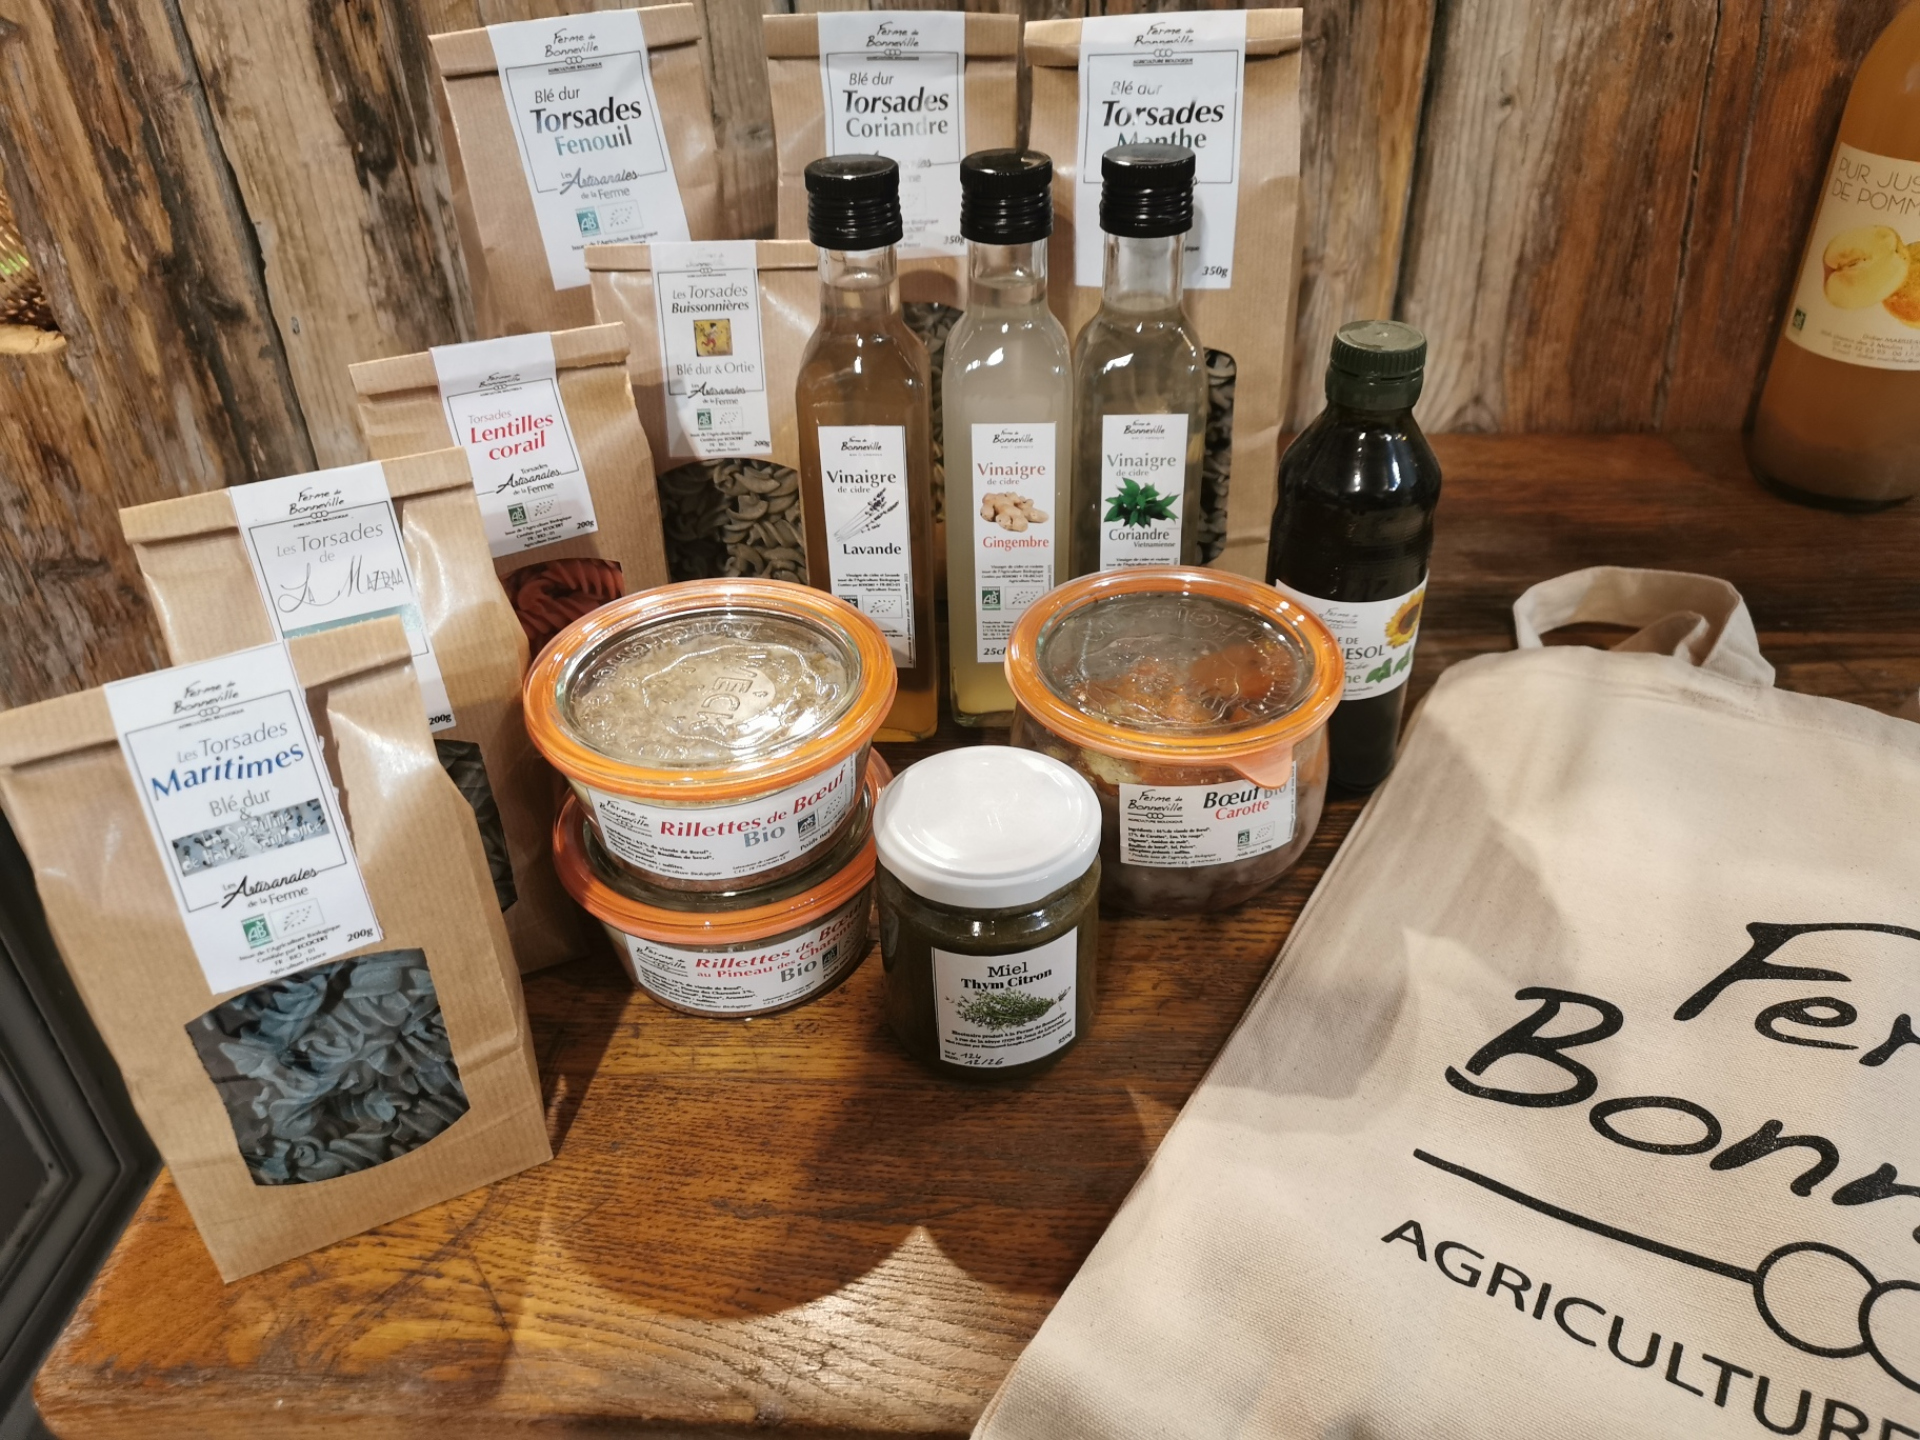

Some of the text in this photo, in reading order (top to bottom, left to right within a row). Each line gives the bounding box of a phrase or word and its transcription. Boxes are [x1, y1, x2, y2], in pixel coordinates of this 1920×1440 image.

[553, 28, 584, 44] Ferme
[876, 21, 907, 36] Ferme
[1146, 22, 1181, 36] Ferme
[866, 35, 919, 47] Bonneville
[545, 43, 598, 57] Bonneville
[849, 72, 894, 86] Blé dur
[535, 86, 580, 104] Blé dur
[1111, 80, 1133, 96] Blé
[842, 86, 949, 114] Torsades
[530, 96, 642, 134] Torsades
[1102, 98, 1225, 127] Torsades
[846, 115, 948, 138] Coriandre
[555, 124, 632, 156] Fenouil
[1838, 157, 1871, 184] PUR
[560, 167, 638, 195] Artisanales
[581, 192, 589, 200] de
[598, 187, 630, 200] Ferme
[1832, 177, 1853, 203] DE
[1202, 266, 1228, 278] 350g
[673, 283, 748, 300] Les Torsades
[671, 300, 750, 314] Buissonnières
[676, 361, 755, 376] Blé dur & Ortie
[688, 381, 746, 399] Artisanales
[715, 398, 739, 406] Ferme
[468, 409, 512, 425] Torsades
[470, 414, 554, 444] Lentilles
[1123, 425, 1165, 435] Bonneville
[489, 430, 546, 460] corail
[841, 441, 882, 451] Bonneville
[992, 433, 1033, 443] Bonneville
[1107, 453, 1177, 471] Vinaigre
[826, 469, 897, 488] Vinaigre
[977, 462, 1046, 480] Vinaigre
[1116, 469, 1149, 477] de cidre
[496, 469, 562, 494] Artisanales
[527, 481, 554, 495] Ferme
[298, 487, 330, 502] Ferme
[289, 498, 345, 515] Bonneville
[576, 520, 595, 530] 200g
[277, 522, 384, 558] Les Torsades
[1109, 528, 1170, 541] Coriandre
[843, 542, 902, 555] Lavande
[983, 535, 1050, 552] Gingembre
[319, 551, 335, 564] de
[1344, 644, 1385, 659] ESOL
[184, 680, 221, 699] Ferme
[173, 690, 239, 715] Bonneville
[429, 713, 452, 726] 200g
[177, 722, 288, 764] Les Torsades
[151, 743, 304, 801] Maritimes
[209, 788, 271, 817] Blé dur
[661, 817, 761, 837] Rillettes
[767, 811, 787, 824] de
[793, 764, 846, 815] Bœuf
[1139, 789, 1172, 802] Ferme
[1203, 787, 1261, 809] Bœuf
[239, 807, 254, 821] &
[606, 800, 636, 817] Ferme
[1127, 799, 1183, 812] Bonneville
[1215, 800, 1270, 820] Carotte
[599, 802, 650, 828] Bonneville
[744, 826, 785, 848] Bio
[221, 868, 319, 909] Les Artisanales
[247, 886, 309, 908] de la Ferme
[307, 924, 340, 938] Biologique
[347, 928, 374, 942] 200g
[297, 935, 328, 950] ECOCERT
[636, 947, 686, 969] Bonneville
[644, 946, 674, 960] Ferme
[696, 949, 790, 969] Rillettes
[796, 941, 814, 953] de
[717, 966, 773, 978] Pineau
[777, 960, 796, 970] des
[781, 961, 817, 983] Bio
[987, 962, 1029, 978] Miel
[961, 969, 1052, 992] Thym Citron
